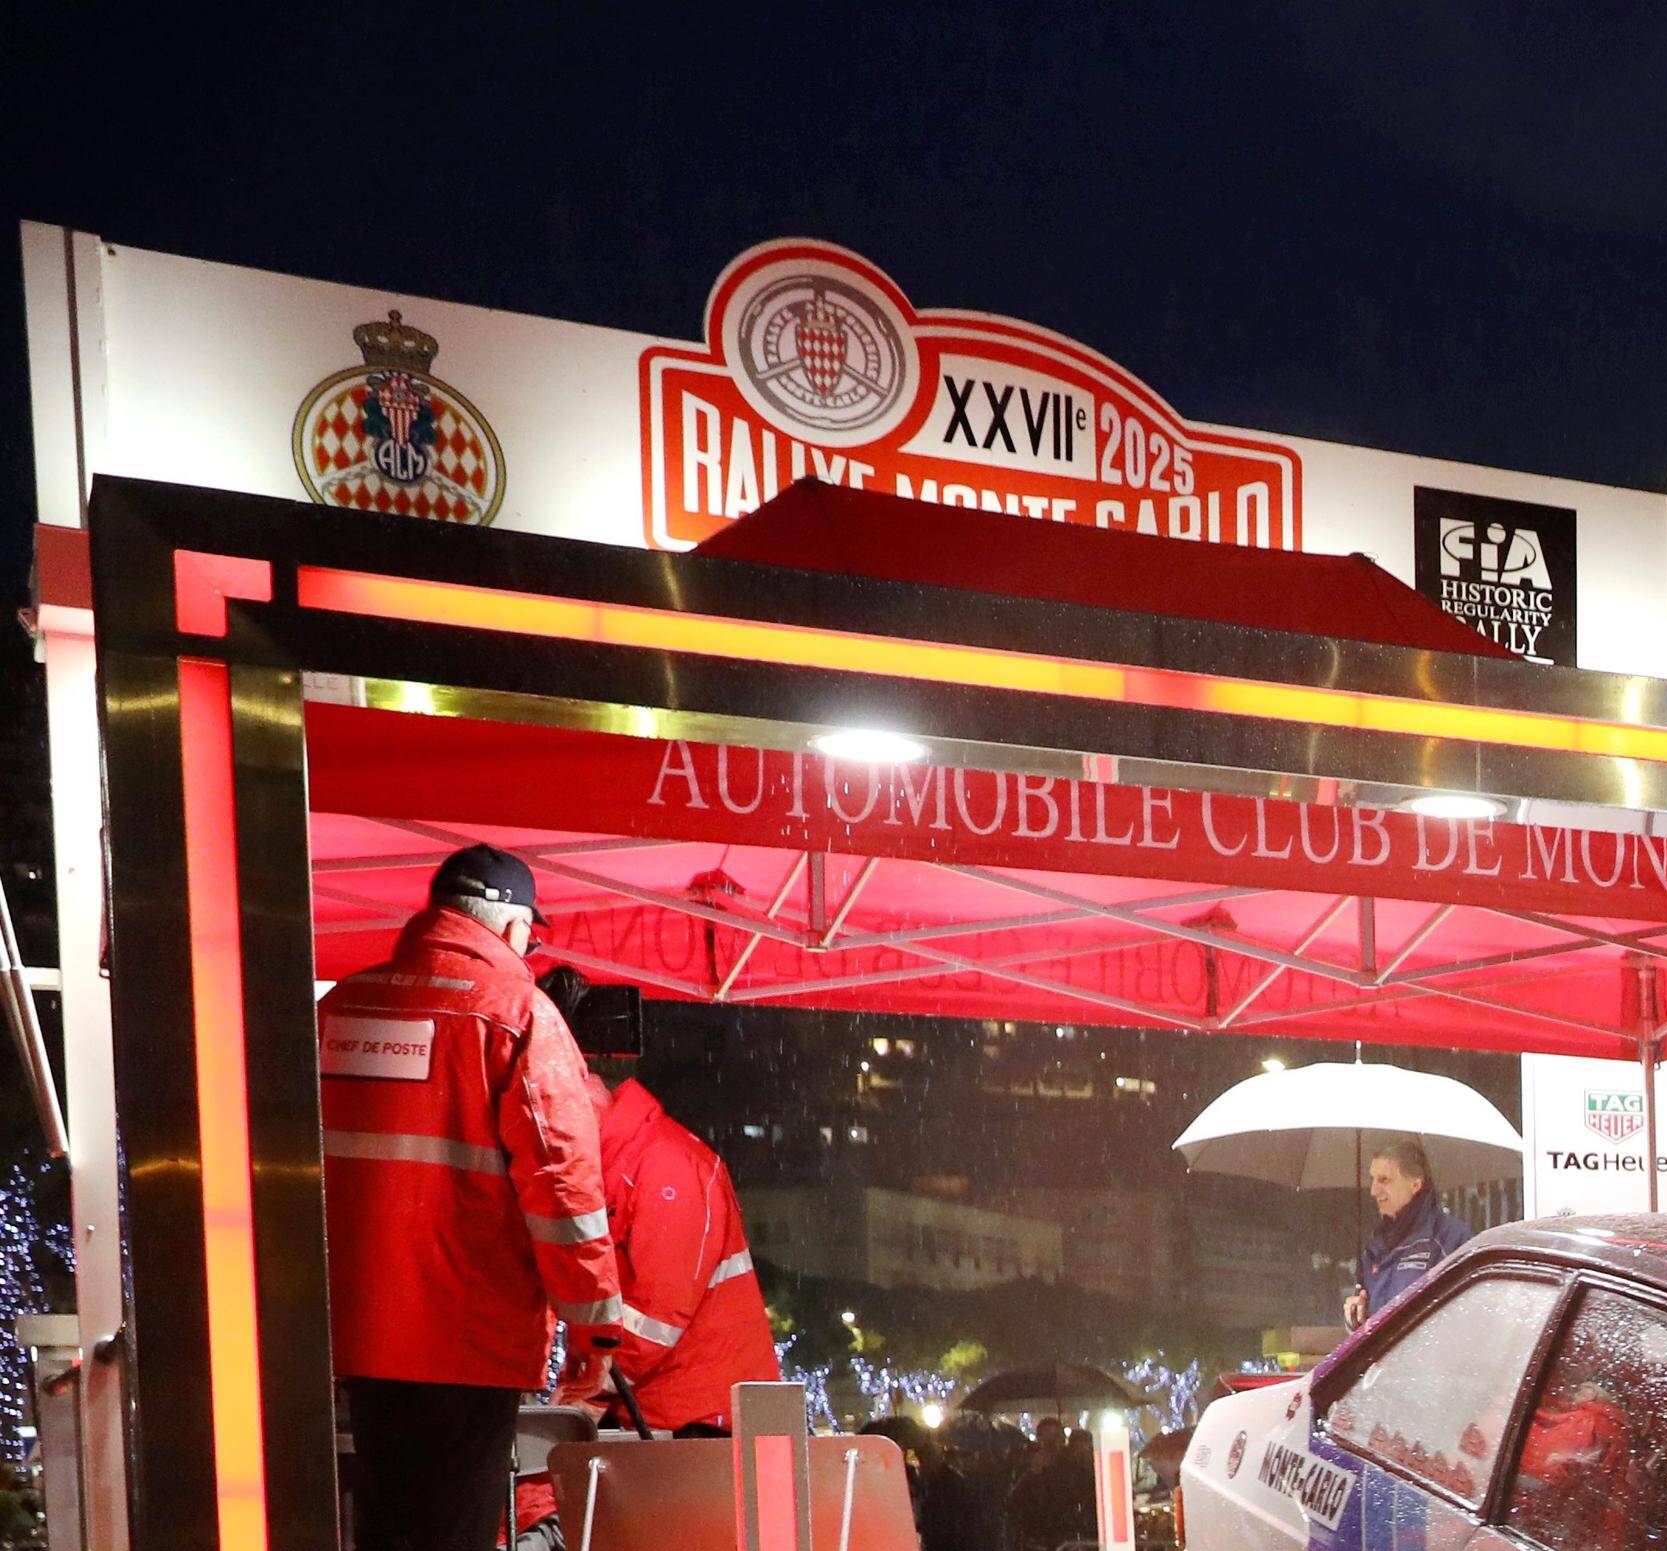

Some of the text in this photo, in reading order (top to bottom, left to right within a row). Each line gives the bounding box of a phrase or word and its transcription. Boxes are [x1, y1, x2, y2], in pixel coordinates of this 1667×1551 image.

[378, 439, 427, 481] ACM
[1100, 401, 1195, 495] 2025
[1441, 579, 1553, 613] HISTORIC
[1441, 599, 1553, 627] REGULARITY
[647, 740, 1181, 851] AUTOMOBILE
[1202, 790, 1392, 866] CLUB
[1412, 814, 1502, 877] DE
[326, 1039, 427, 1057] CHEF DE POSTE
[1590, 1094, 1641, 1113] TAG
[1588, 1113, 1643, 1141] HEUER
